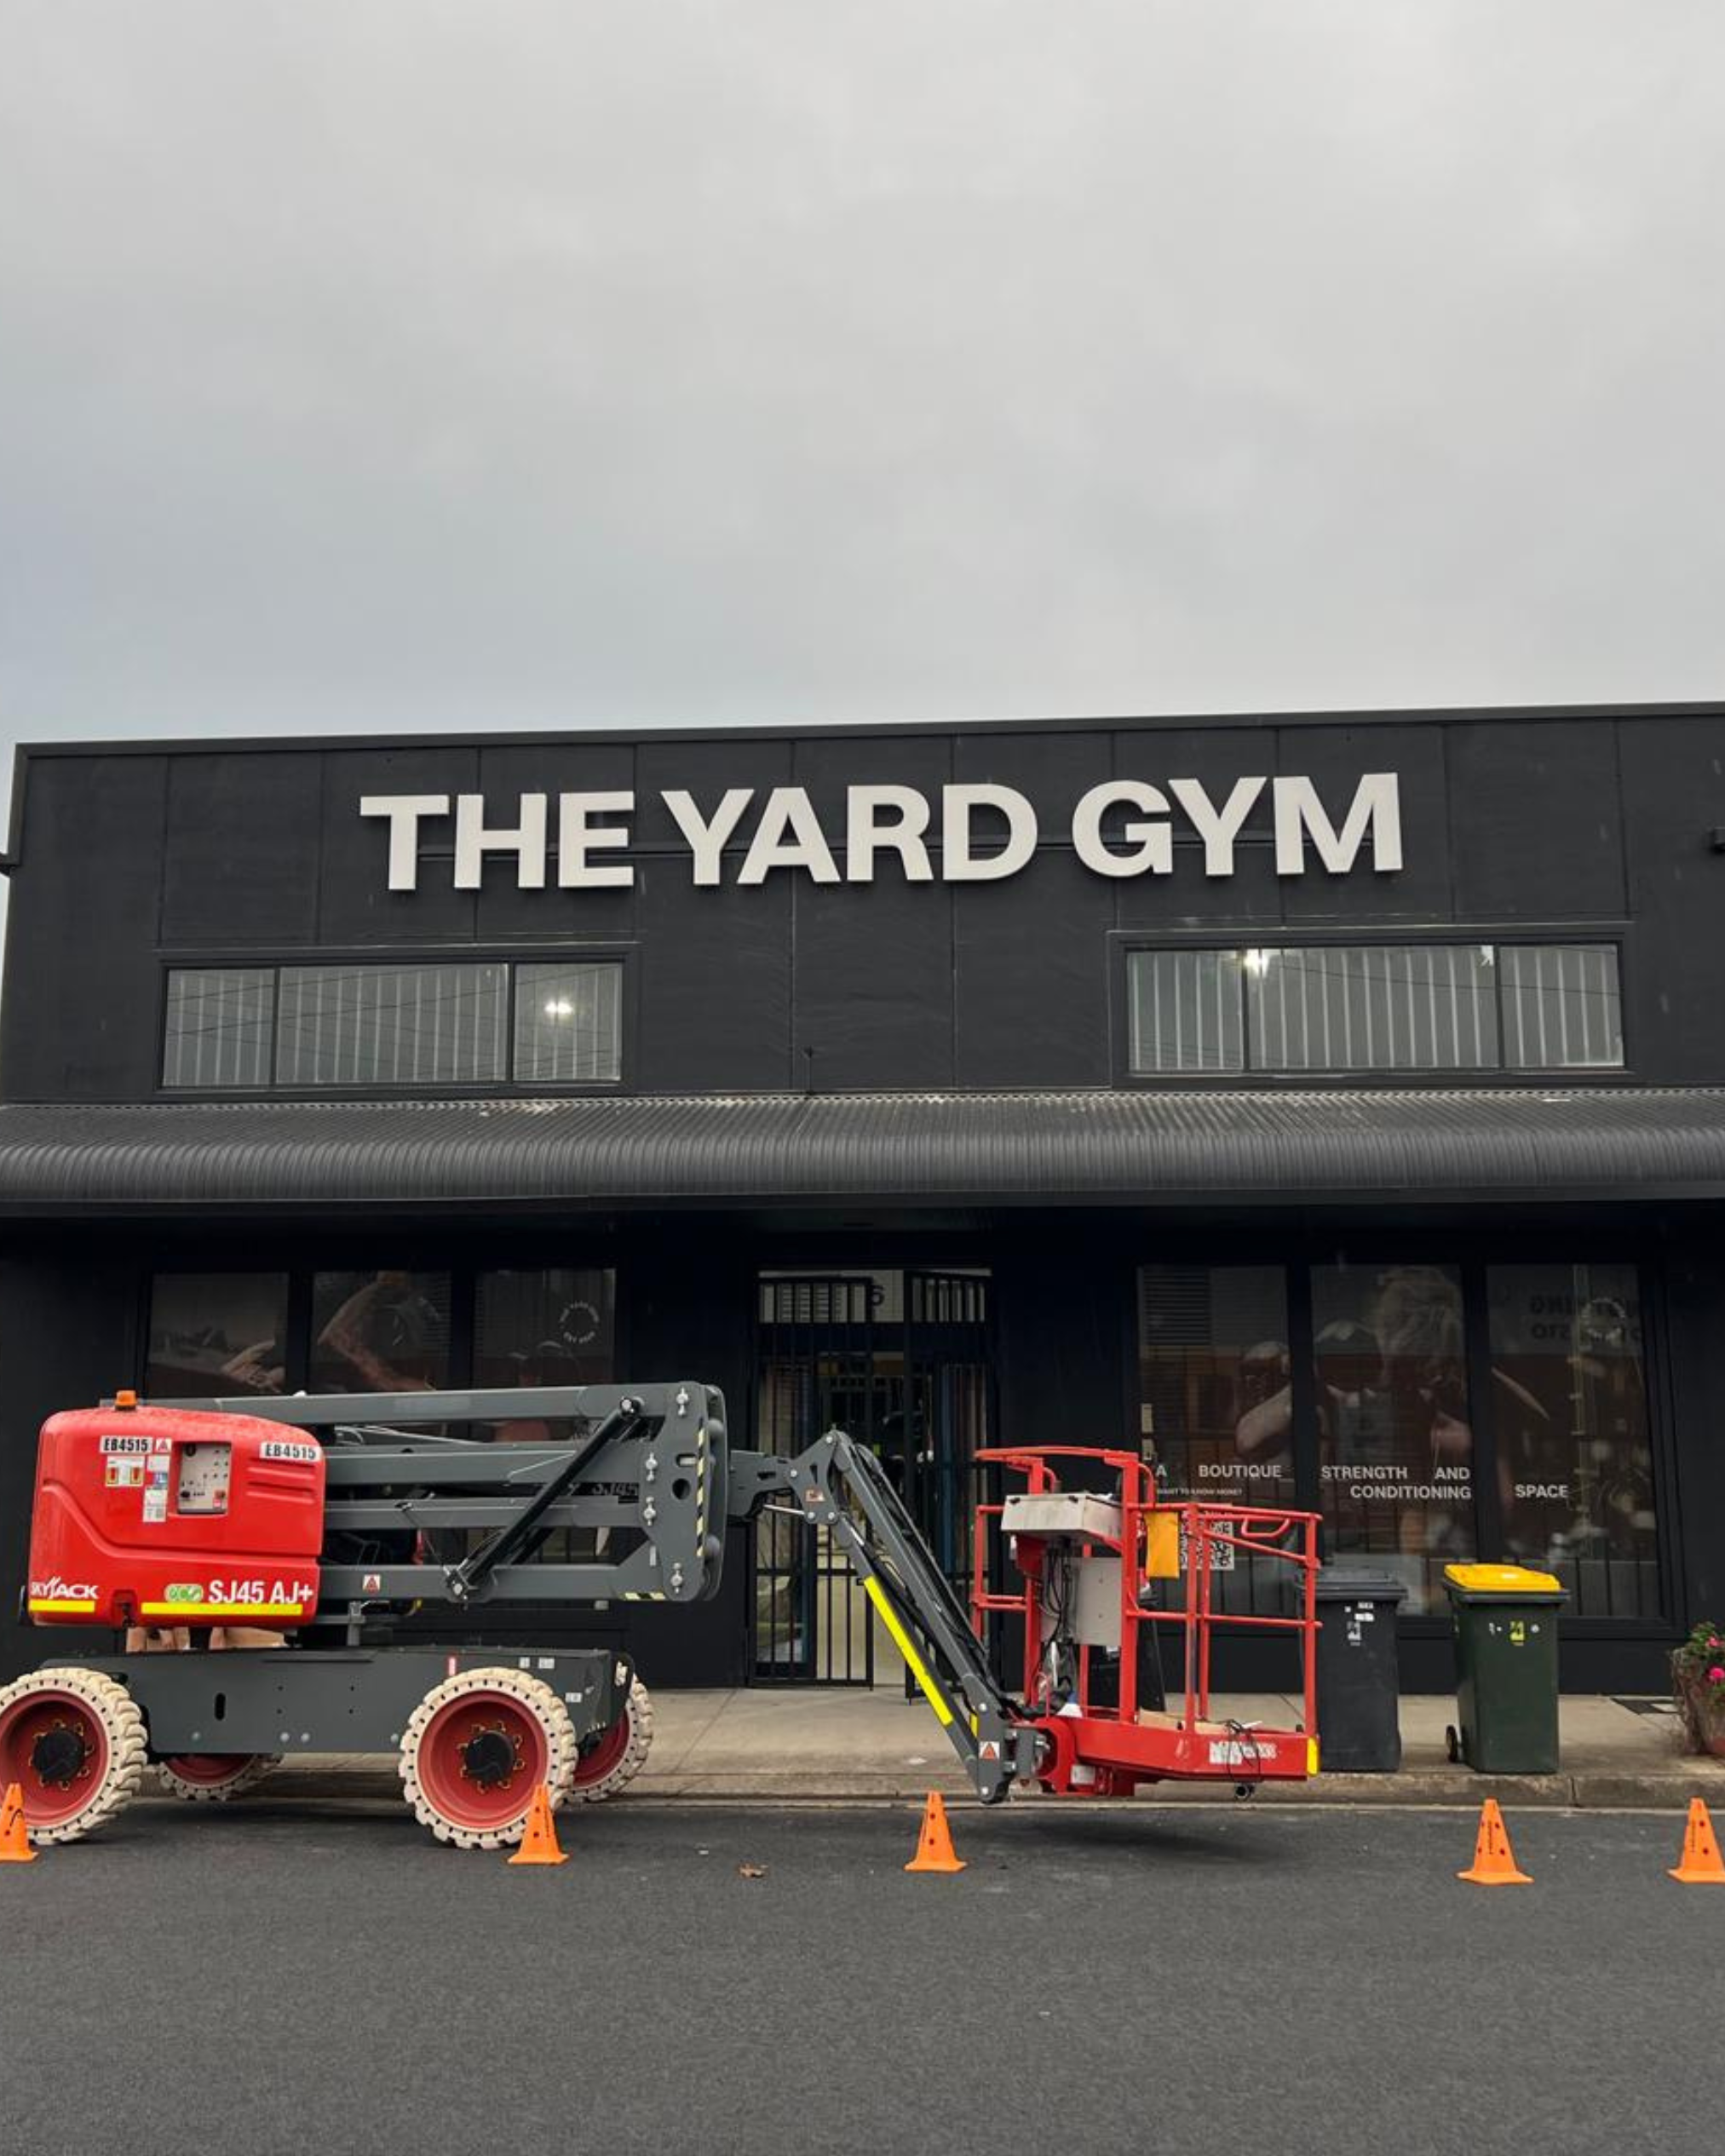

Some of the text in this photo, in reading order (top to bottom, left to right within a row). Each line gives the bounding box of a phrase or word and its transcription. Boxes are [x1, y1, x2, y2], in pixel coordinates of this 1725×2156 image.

[359, 773, 1404, 890] THE YARD GYM
[104, 1437, 149, 1452] EB4515
[265, 1442, 317, 1460] EB4515
[1156, 1464, 1470, 1480] A BOUTIQUE STRENGTH AND
[1350, 1484, 1568, 1499] CONDITIONING SPACE
[208, 1579, 265, 1604] SJ45
[268, 1580, 313, 1604] AJ+
